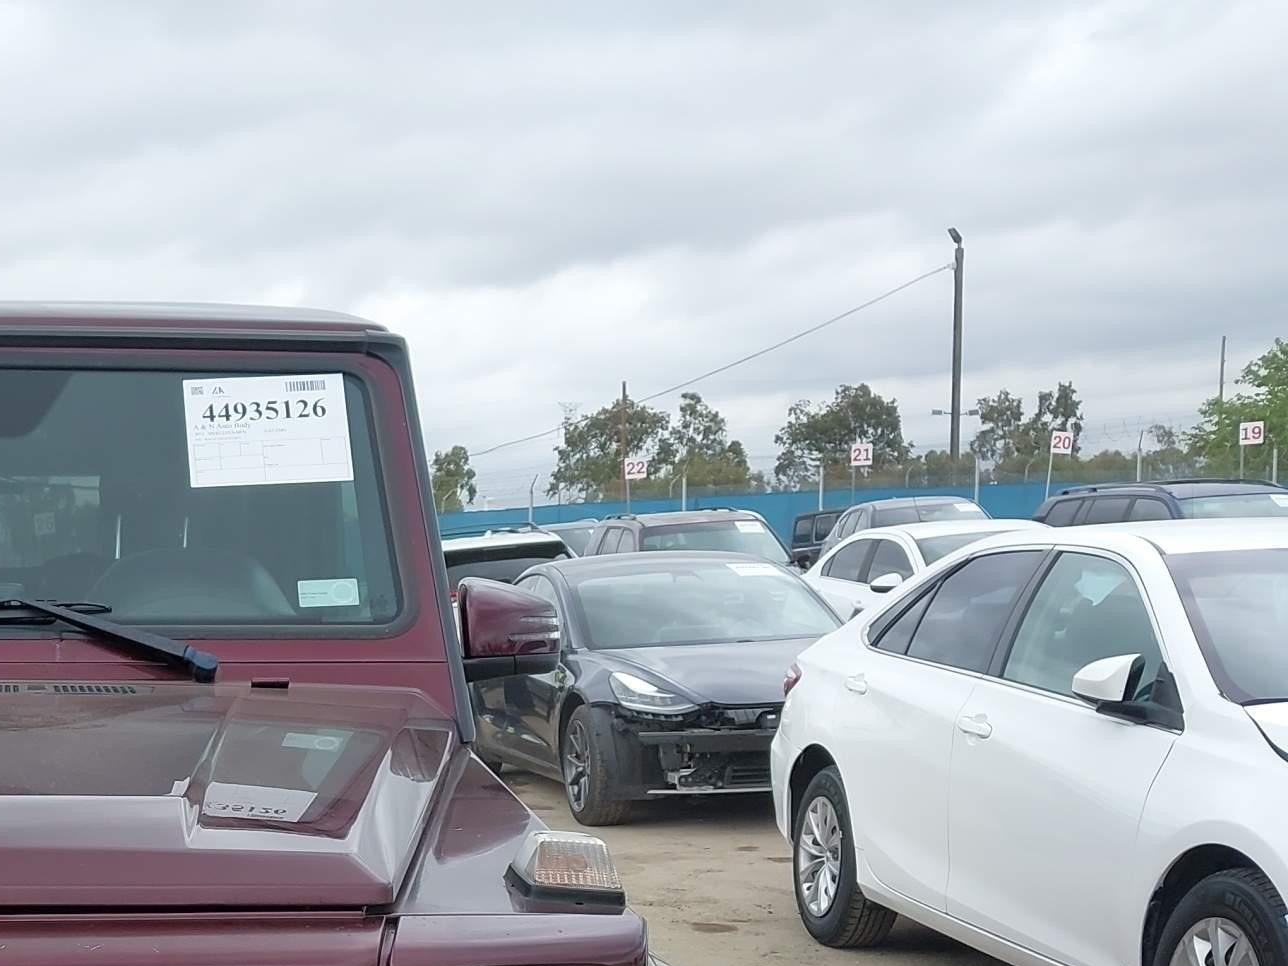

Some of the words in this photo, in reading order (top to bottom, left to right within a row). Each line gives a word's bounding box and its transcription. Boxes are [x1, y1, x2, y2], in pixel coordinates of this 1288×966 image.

[202, 398, 326, 422] 44935126
[1241, 425, 1262, 440] 19
[1052, 435, 1072, 450] 20
[852, 447, 872, 462] 21
[626, 461, 646, 475] 22
